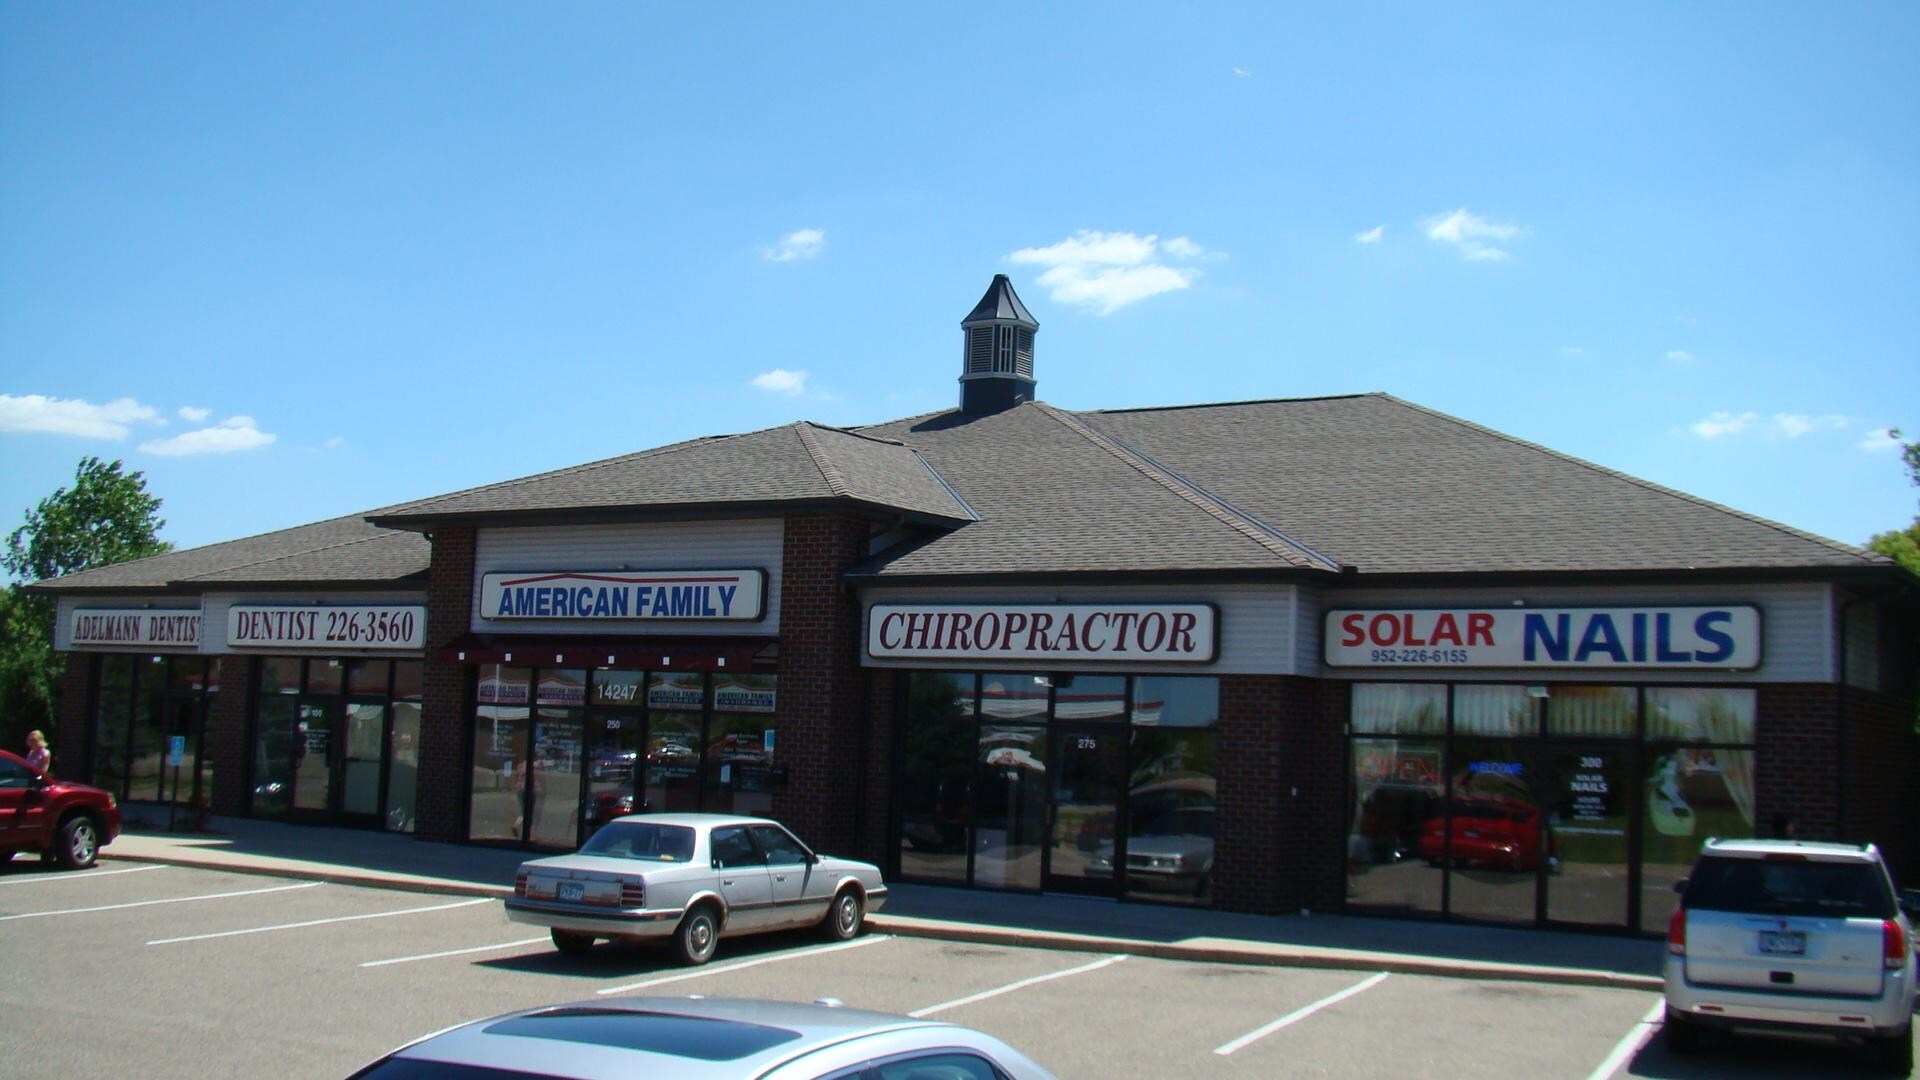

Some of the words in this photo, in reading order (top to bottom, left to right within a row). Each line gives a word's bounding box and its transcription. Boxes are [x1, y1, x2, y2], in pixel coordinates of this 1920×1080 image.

[498, 587, 628, 616] AMERICAN
[636, 585, 736, 617] FAMILY
[75, 615, 141, 640] ADELMANN
[236, 611, 319, 640] DENTIST
[326, 611, 414, 642] 226-3560
[879, 612, 1197, 653] CHIROPRACTOR
[1341, 613, 1495, 646] SOLAR
[1523, 611, 1735, 662] NAILS
[1371, 649, 1468, 663] 952-226-6155
[597, 684, 638, 701] 14247
[606, 720, 620, 729] 250
[1078, 739, 1096, 749] 275
[1580, 756, 1603, 768] 300
[1570, 782, 1608, 793] NAILS
